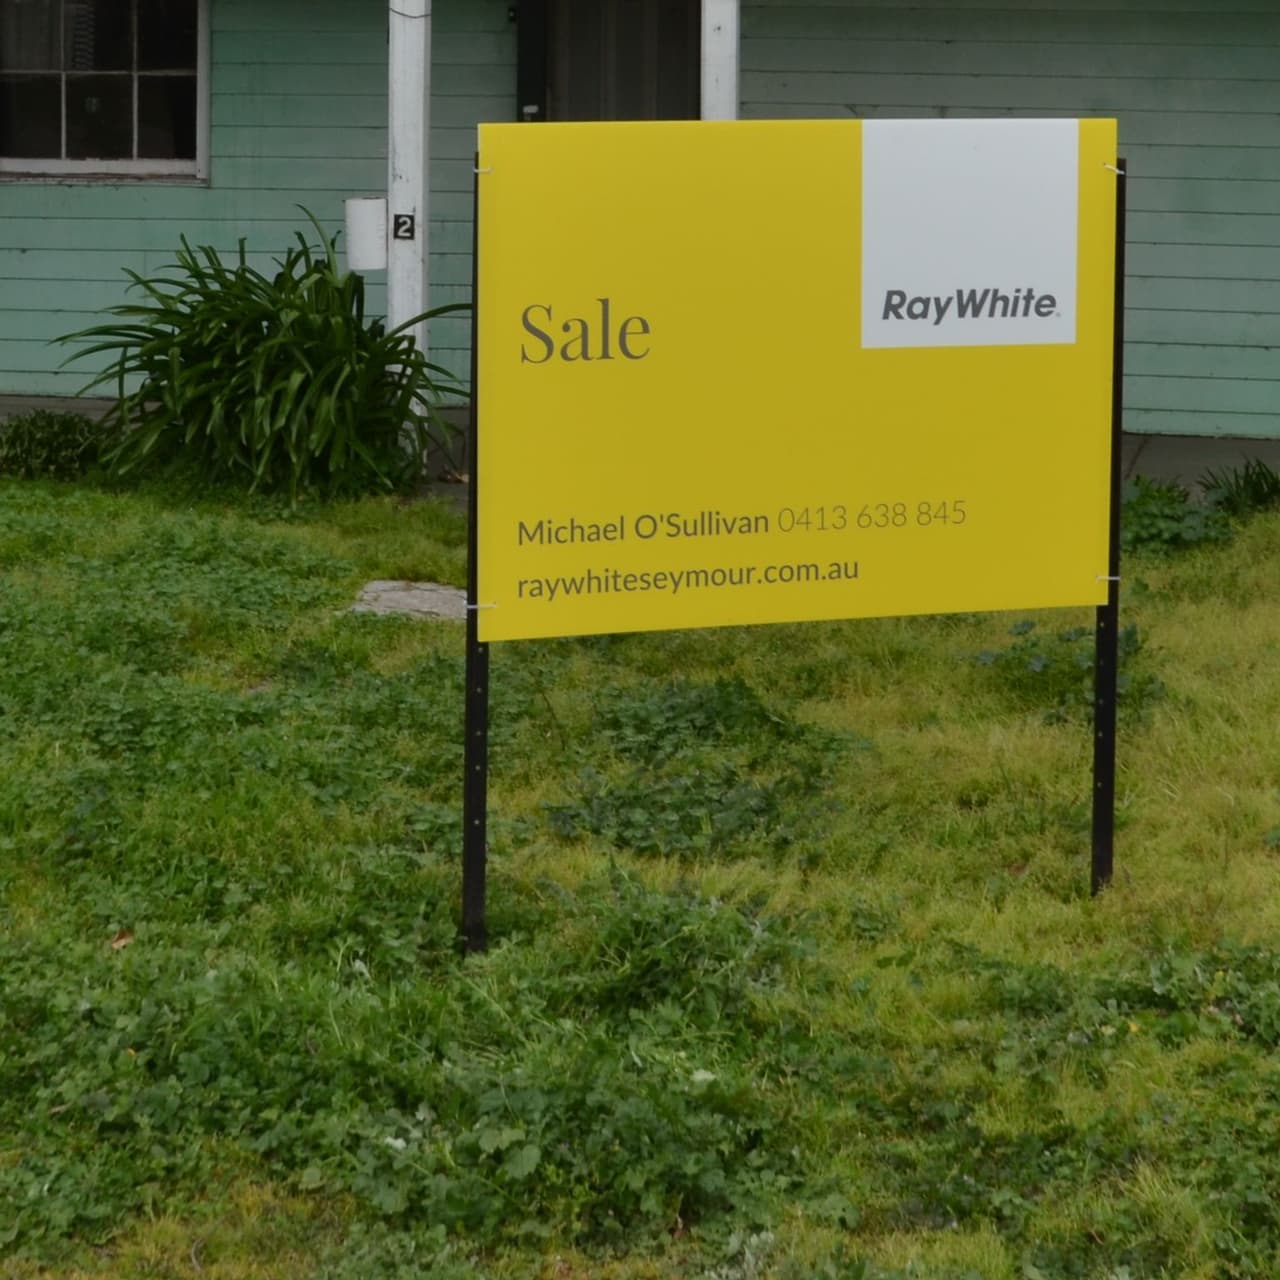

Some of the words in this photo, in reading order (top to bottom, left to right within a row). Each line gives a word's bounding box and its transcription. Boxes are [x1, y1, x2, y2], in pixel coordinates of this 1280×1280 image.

[396, 216, 412, 237] 2
[520, 297, 651, 364] Sale
[518, 514, 625, 547] Michael
[634, 510, 769, 540] O'Sullivan
[777, 504, 848, 533] 0413
[856, 502, 908, 529] 638
[916, 499, 967, 527] 845
[518, 561, 859, 602] raywhiteseymour.com.au
